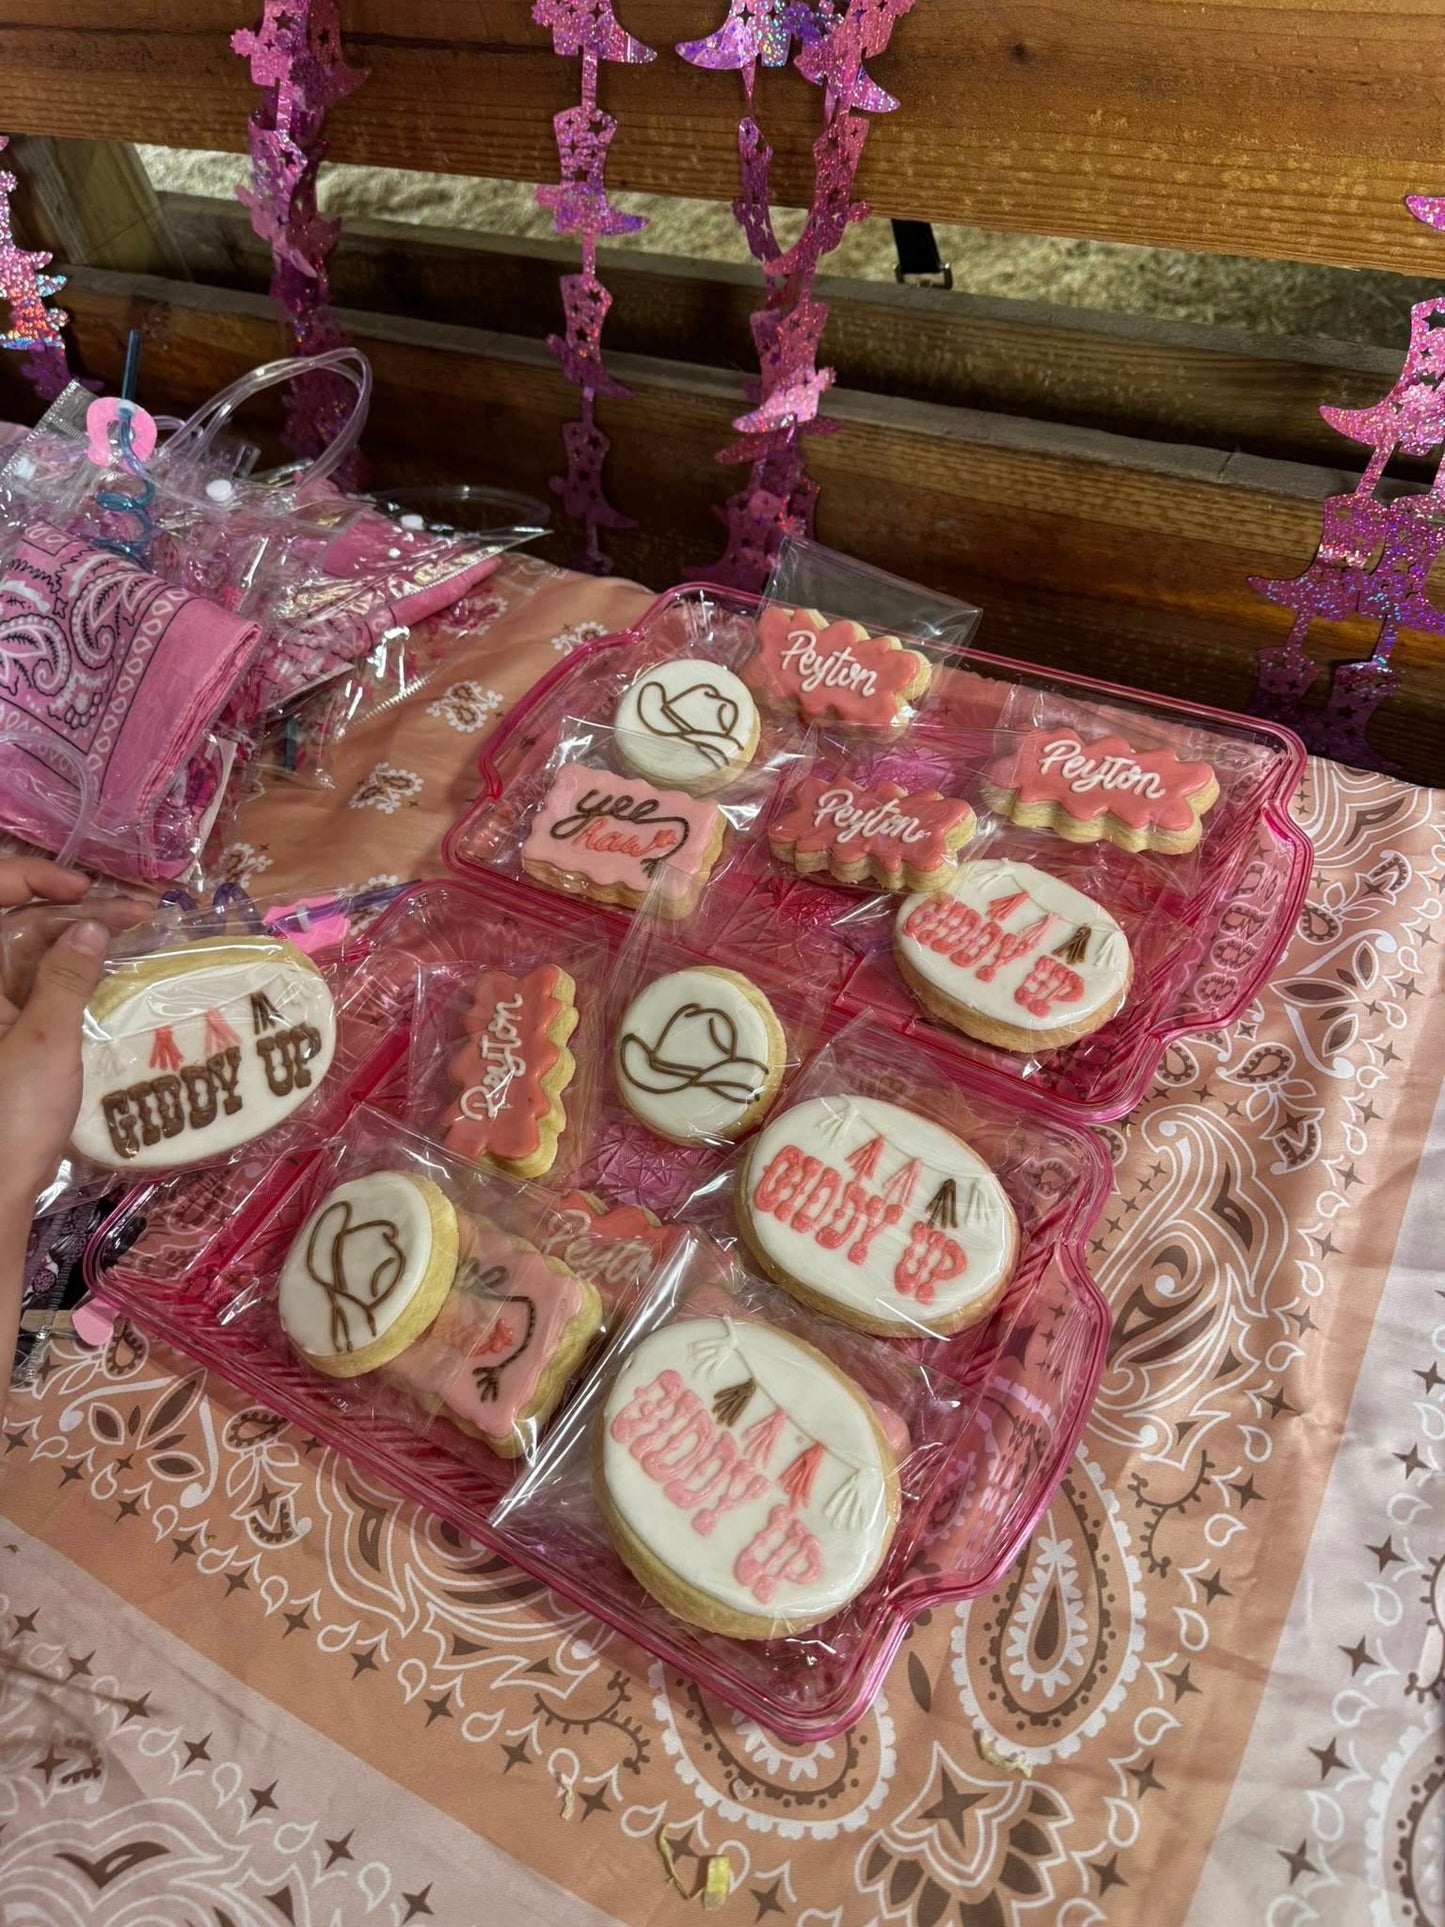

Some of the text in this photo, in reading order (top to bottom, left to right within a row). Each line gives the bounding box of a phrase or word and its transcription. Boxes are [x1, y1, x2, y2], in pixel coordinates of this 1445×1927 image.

[780, 629, 878, 698] Peyton
[1038, 738, 1167, 799] Peyton
[550, 788, 662, 840] yee
[813, 788, 927, 843] Peyton
[1013, 953, 1086, 1019] UP
[100, 1021, 322, 1159] GIDDY UP
[753, 1143, 969, 1306] GIDDY UP
[610, 1368, 826, 1606] GIDDY UP
